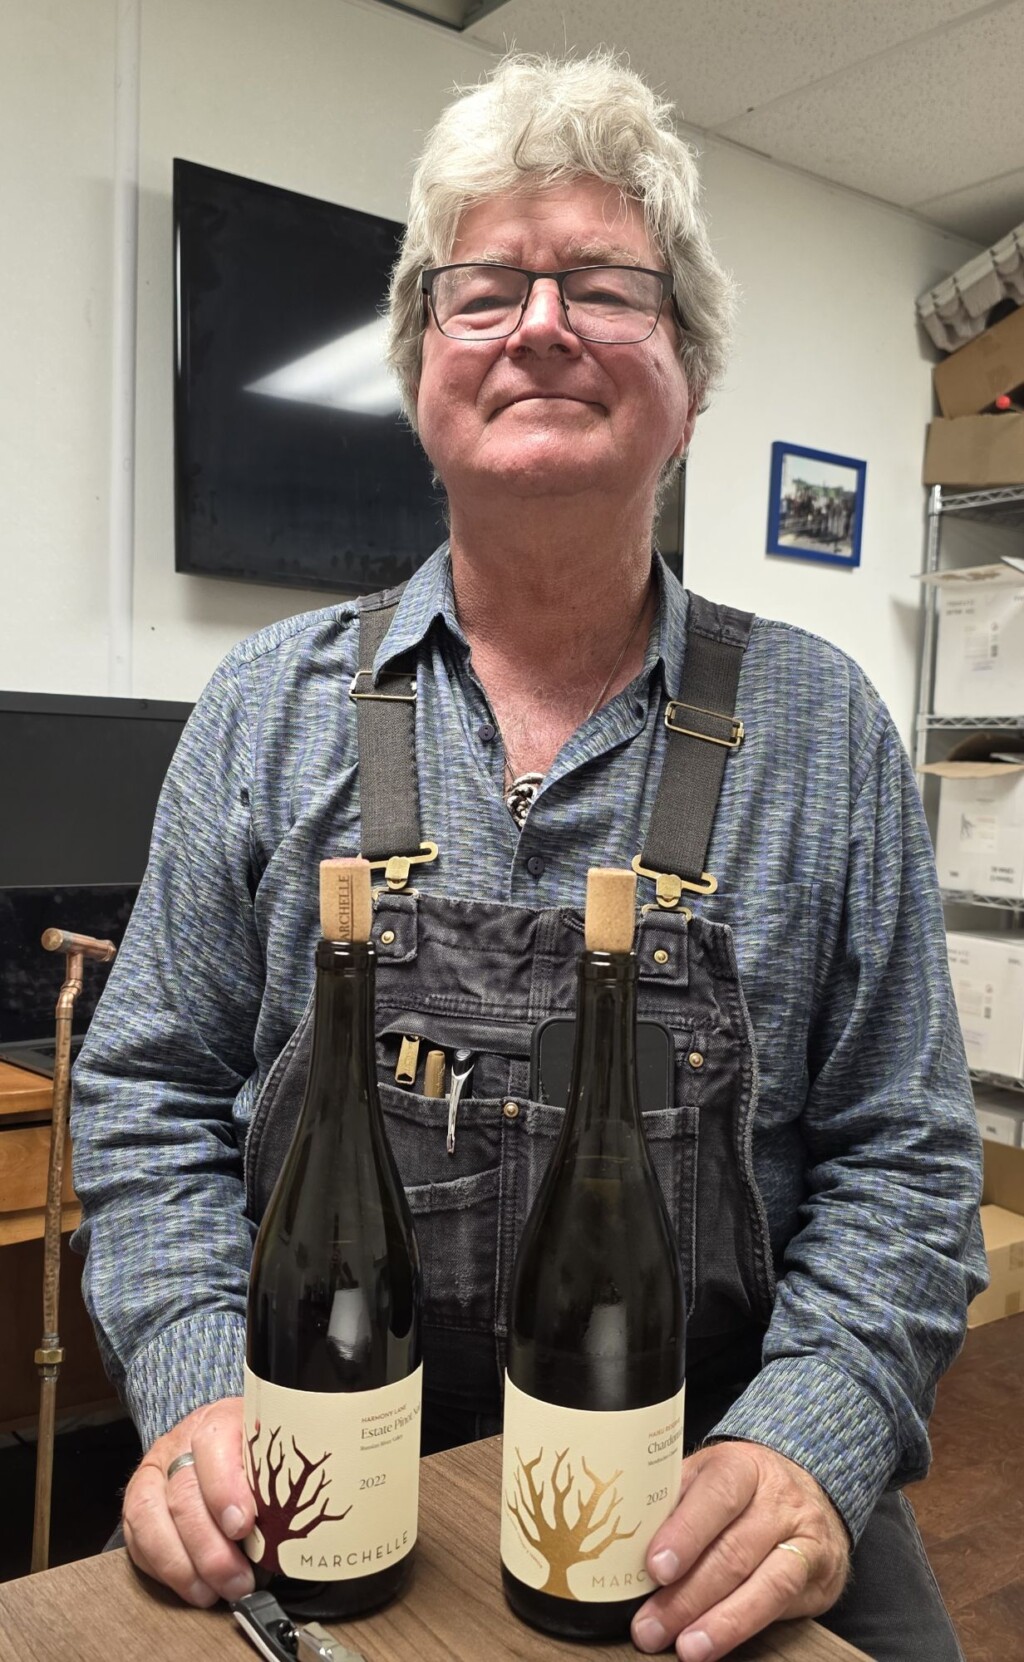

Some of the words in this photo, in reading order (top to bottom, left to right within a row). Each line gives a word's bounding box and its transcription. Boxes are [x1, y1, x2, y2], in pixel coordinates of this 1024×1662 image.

[338, 874, 350, 941] ARCHELLE
[361, 1424, 393, 1439] Estate
[359, 1473, 386, 1490] 2022
[646, 1486, 668, 1506] 2023
[300, 1530, 408, 1567] MARCHELLE
